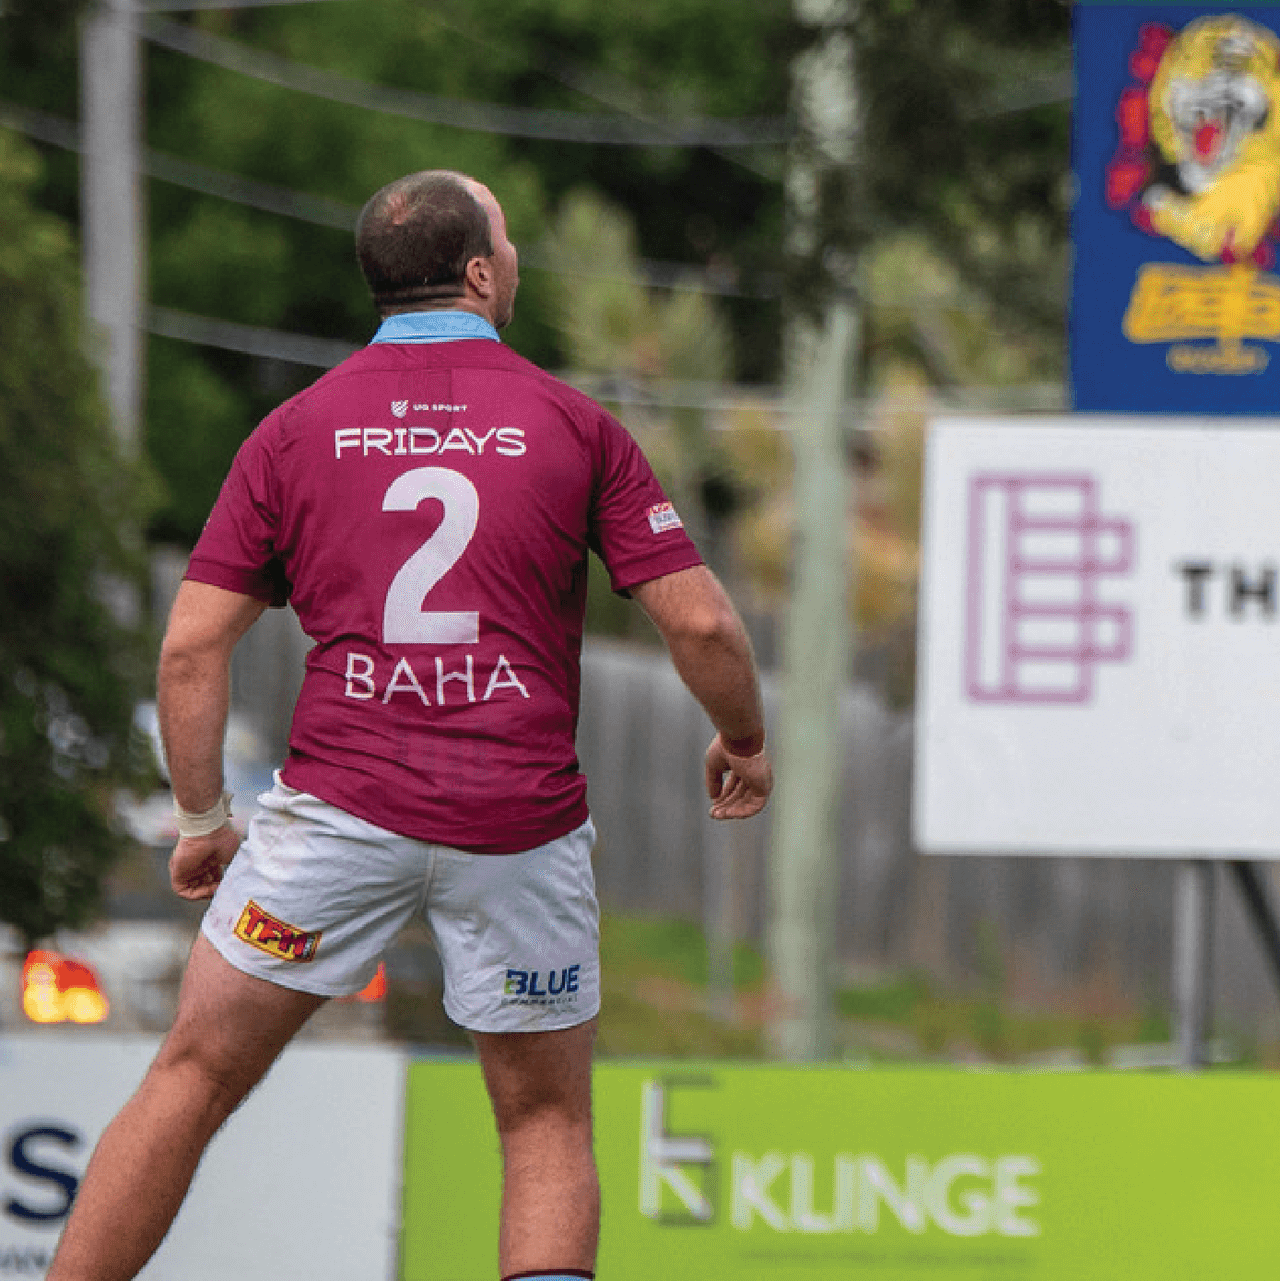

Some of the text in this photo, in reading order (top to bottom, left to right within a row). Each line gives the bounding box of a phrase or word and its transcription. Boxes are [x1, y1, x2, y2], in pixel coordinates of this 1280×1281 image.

[334, 426, 527, 460] FRIDAYS
[380, 466, 480, 644] 2
[343, 651, 532, 707] BAHA
[503, 964, 581, 996] BLUE
[731, 1150, 1040, 1237] KLINGE
